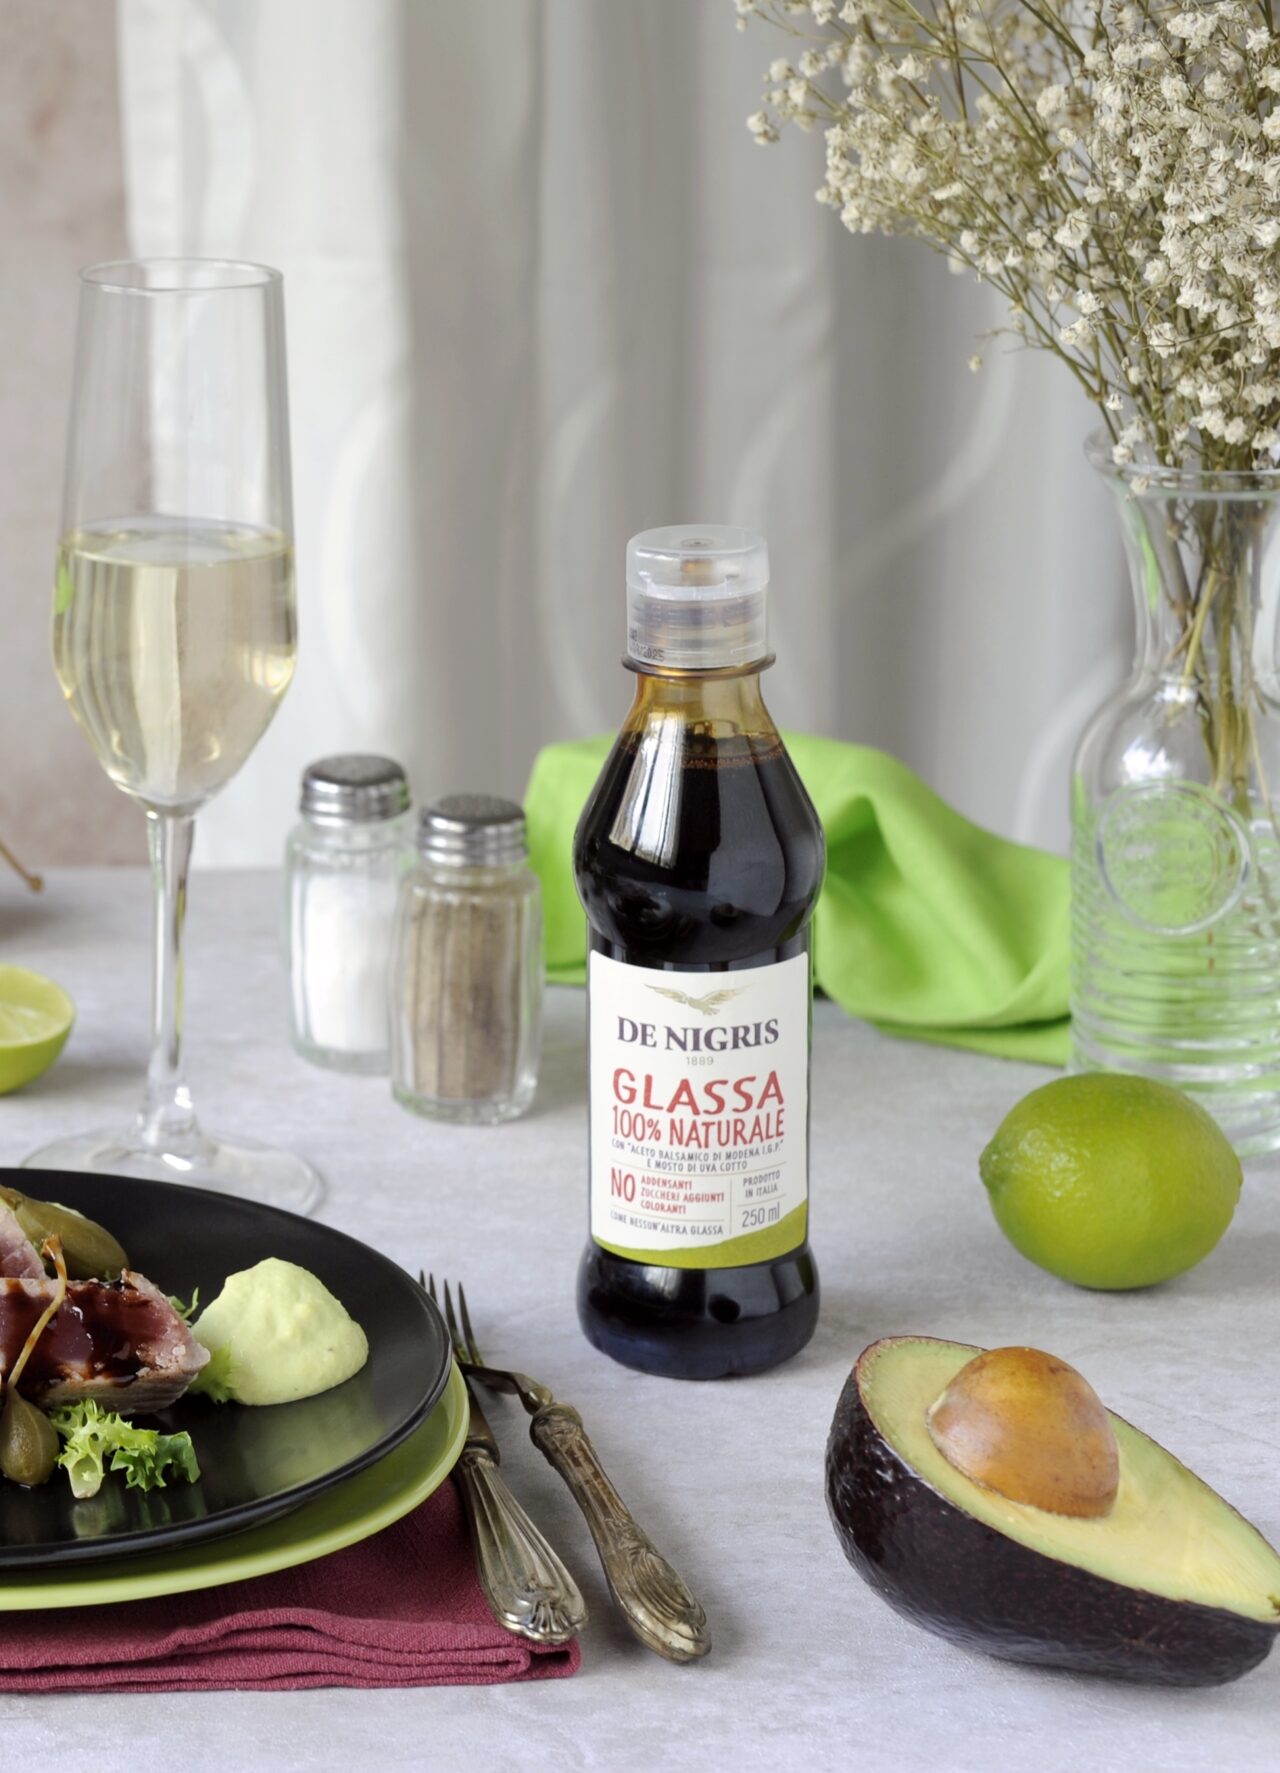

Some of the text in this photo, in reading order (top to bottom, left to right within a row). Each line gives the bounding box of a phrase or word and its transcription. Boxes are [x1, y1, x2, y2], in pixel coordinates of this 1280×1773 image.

[617, 1016, 779, 1052] DE NIGRIS
[686, 1056, 714, 1066] 1889
[613, 1067, 784, 1116] GLASSA
[612, 1105, 785, 1149] 100% NATURALE
[612, 1138, 624, 1150] CON
[658, 1150, 709, 1162] BALSAMICO
[713, 1152, 721, 1161] DI
[725, 1147, 760, 1161] MODENA
[655, 1160, 684, 1172] MOSTO
[687, 1163, 696, 1173] DI
[700, 1163, 717, 1173] UVA
[720, 1160, 748, 1172] COTTO
[611, 1167, 636, 1202] NO
[641, 1176, 692, 1190] ADDENSANTI
[743, 1170, 780, 1187] PRODOTTO
[641, 1187, 724, 1203] ZUCCHERI AGGIUNTI
[745, 1183, 778, 1198] IN ITALIA
[641, 1200, 686, 1214] COLORANTI
[742, 1201, 780, 1228] 250 ml
[610, 1209, 627, 1224] COME
[690, 1225, 724, 1236] GLASSA
